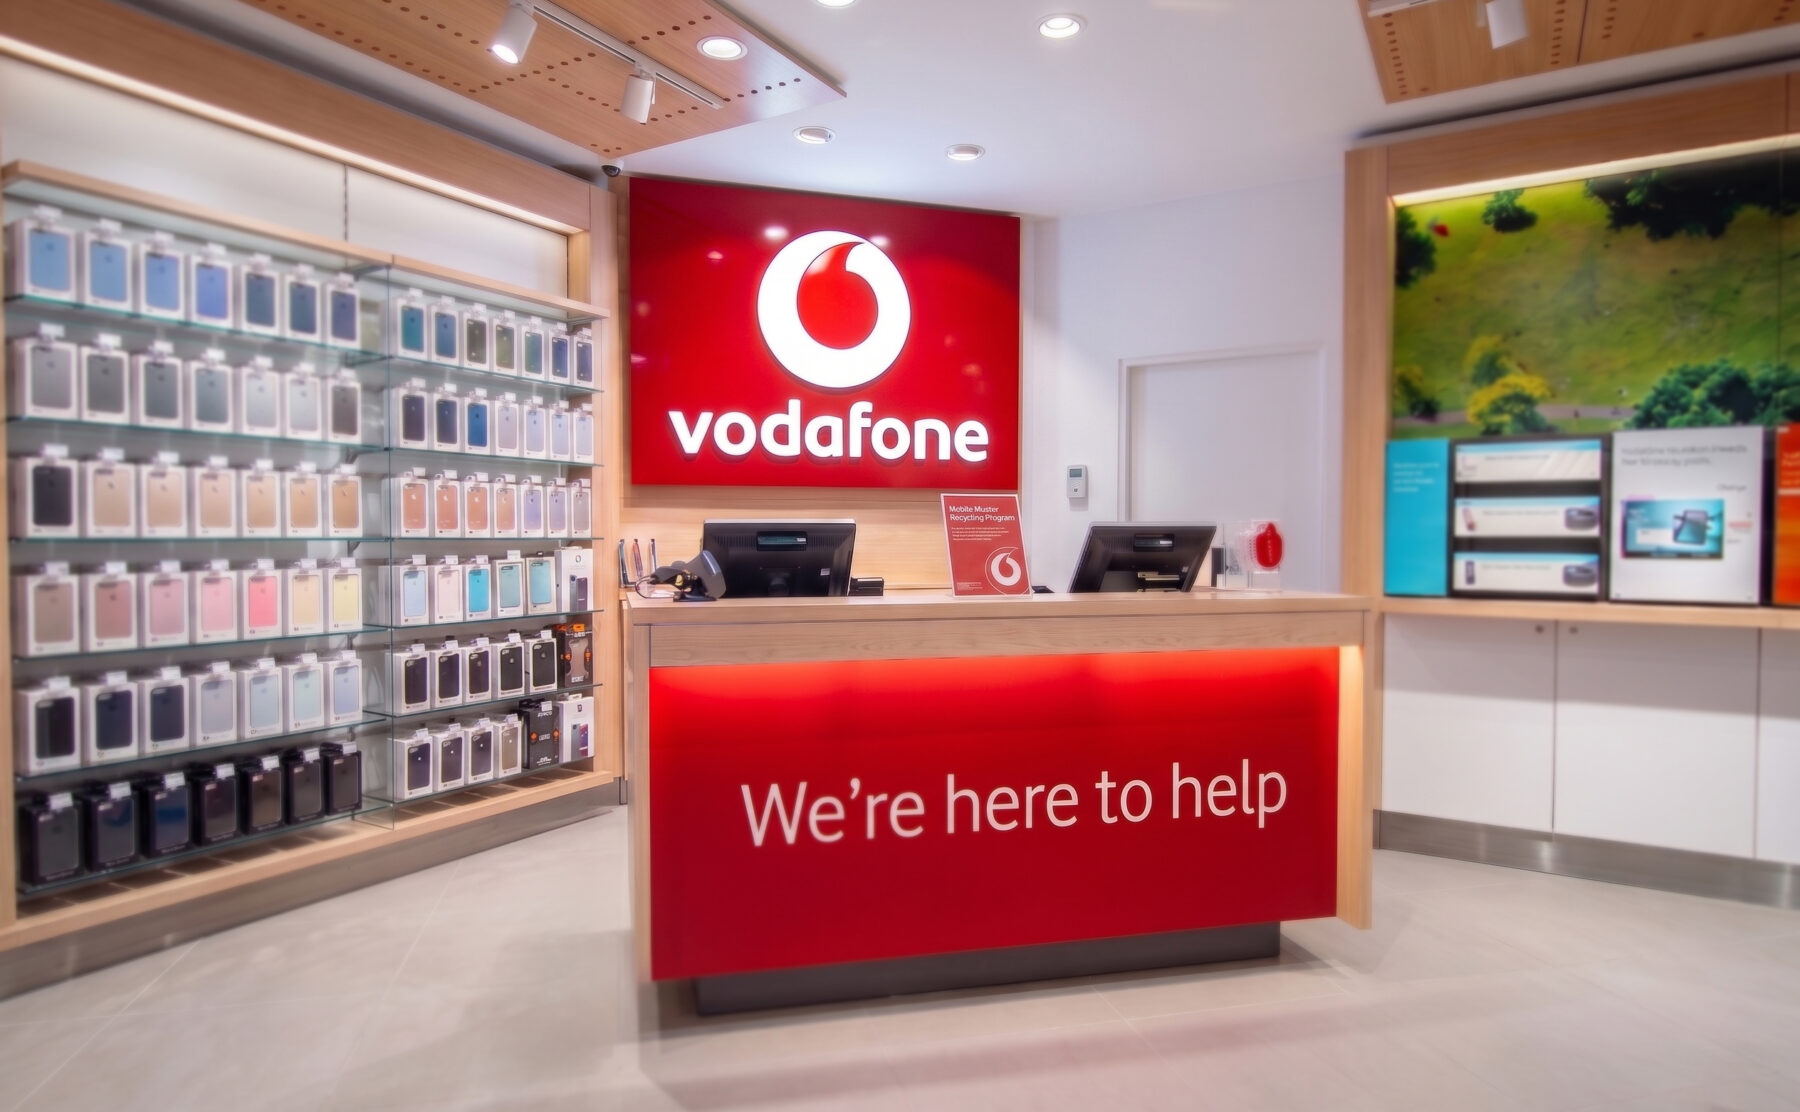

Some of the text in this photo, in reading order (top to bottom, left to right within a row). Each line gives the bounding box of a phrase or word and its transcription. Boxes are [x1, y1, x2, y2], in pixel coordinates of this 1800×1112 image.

[668, 399, 989, 462] vodafone
[949, 505, 999, 513] Mobile Muster
[950, 514, 1015, 523] Recycling Program
[946, 773, 1079, 834] here
[1094, 770, 1153, 824] to
[1172, 758, 1287, 829] help
